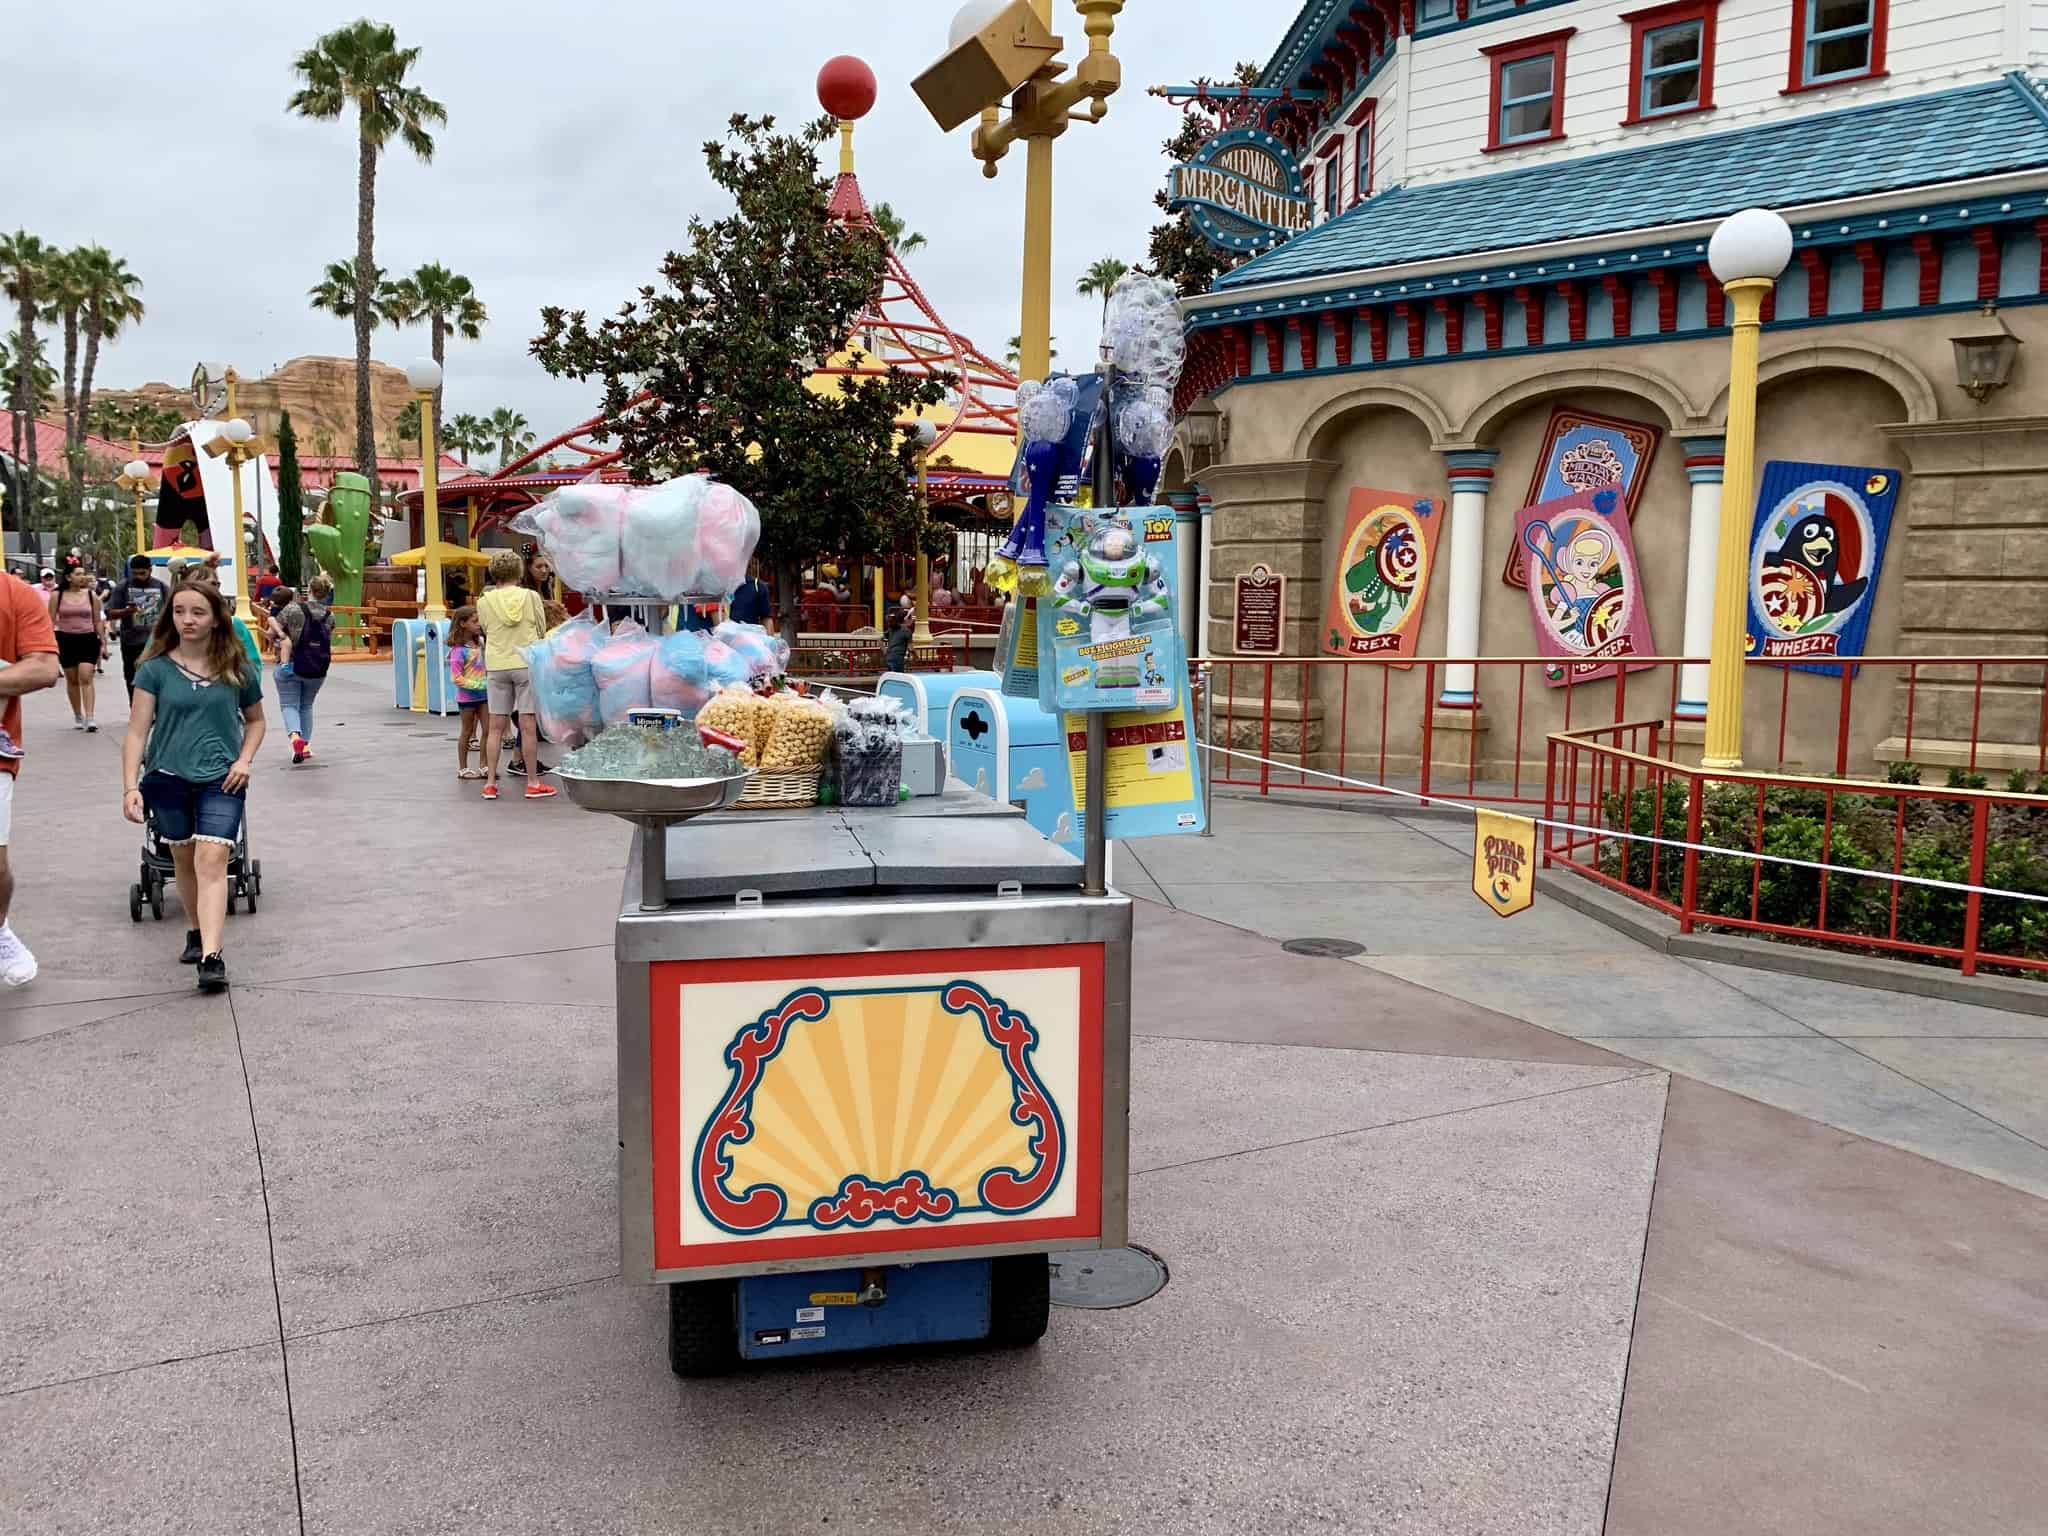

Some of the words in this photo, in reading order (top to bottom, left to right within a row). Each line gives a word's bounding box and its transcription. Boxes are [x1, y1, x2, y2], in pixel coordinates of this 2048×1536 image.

[1221, 149, 1278, 187] MIDWAY
[1182, 167, 1307, 231] MERCANTILE
[1568, 461, 1612, 482] MIDWAY
[1143, 518, 1174, 534] TOY
[1356, 636, 1392, 651] REX
[1771, 636, 1830, 656] WHEEZY
[1483, 835, 1527, 866] PIXAR
[1487, 856, 1521, 882] PIER
